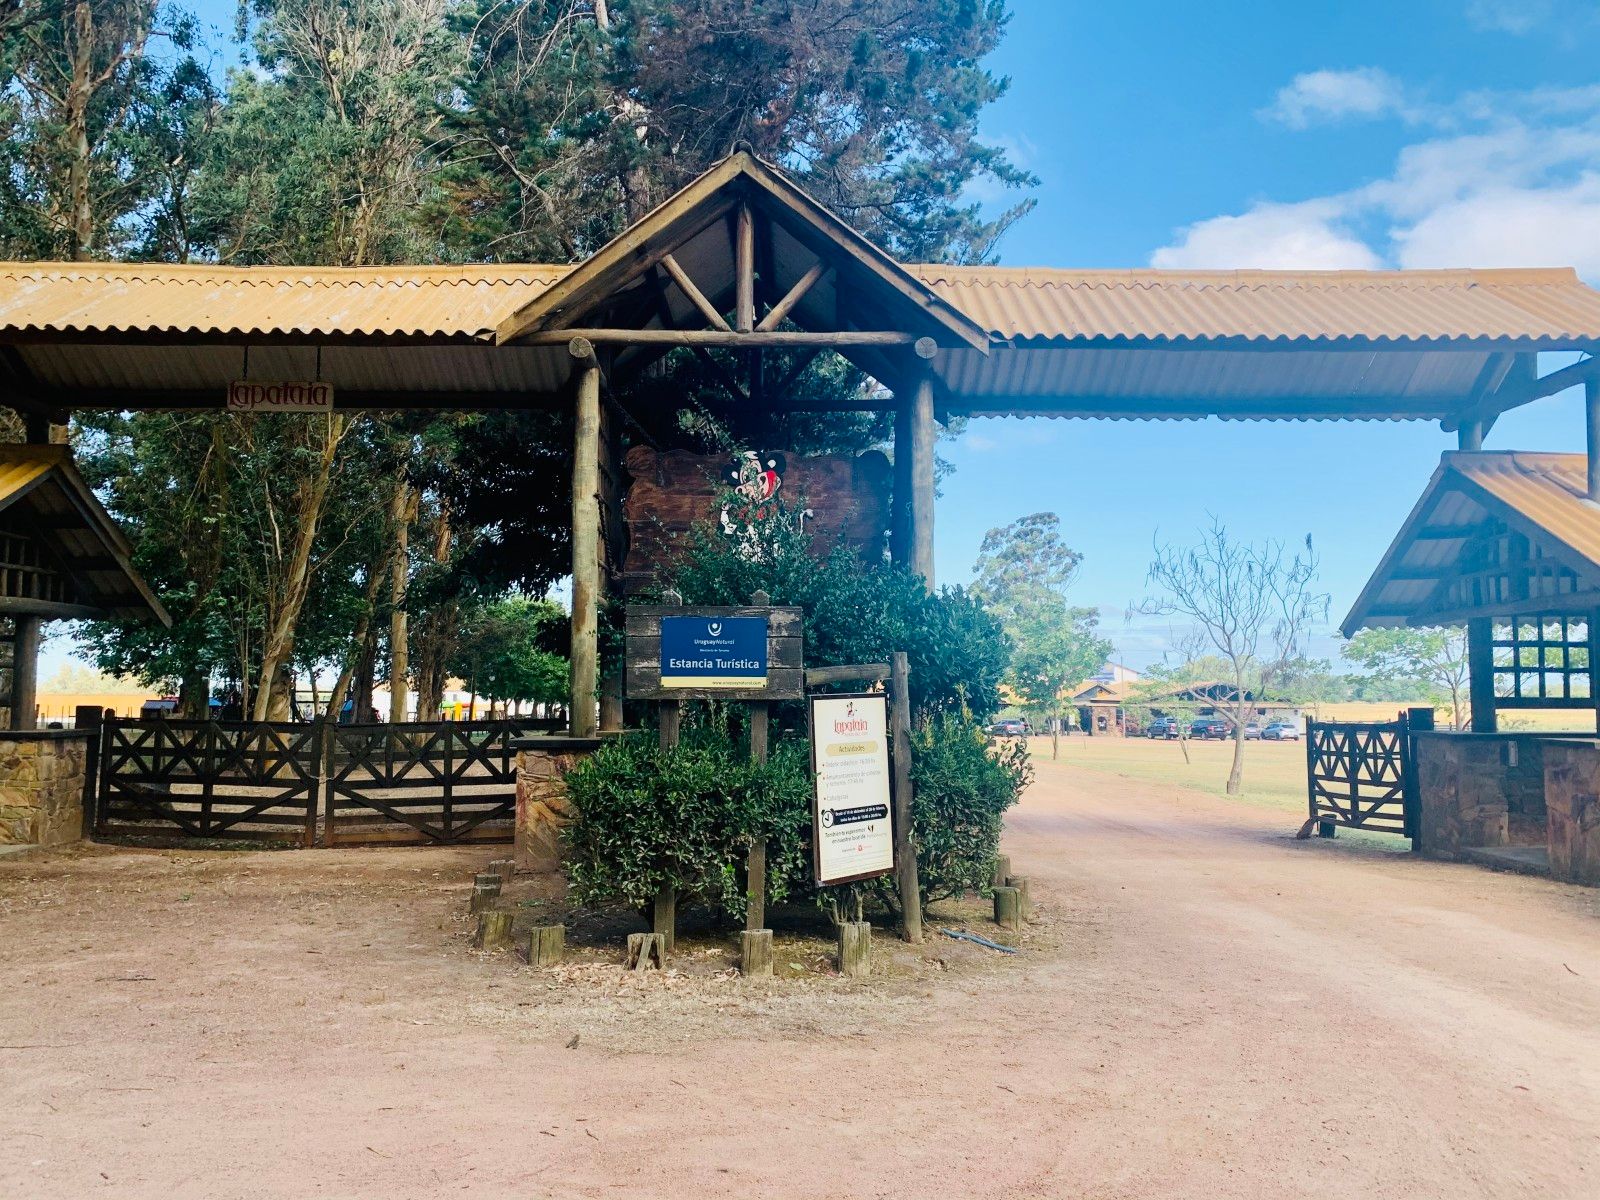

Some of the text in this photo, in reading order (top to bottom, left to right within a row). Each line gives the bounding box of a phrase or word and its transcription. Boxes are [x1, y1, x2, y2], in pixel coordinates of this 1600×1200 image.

[229, 380, 328, 409] Lapataia
[669, 658, 760, 669] Estancia Turística
[838, 745, 865, 753] Actividades
